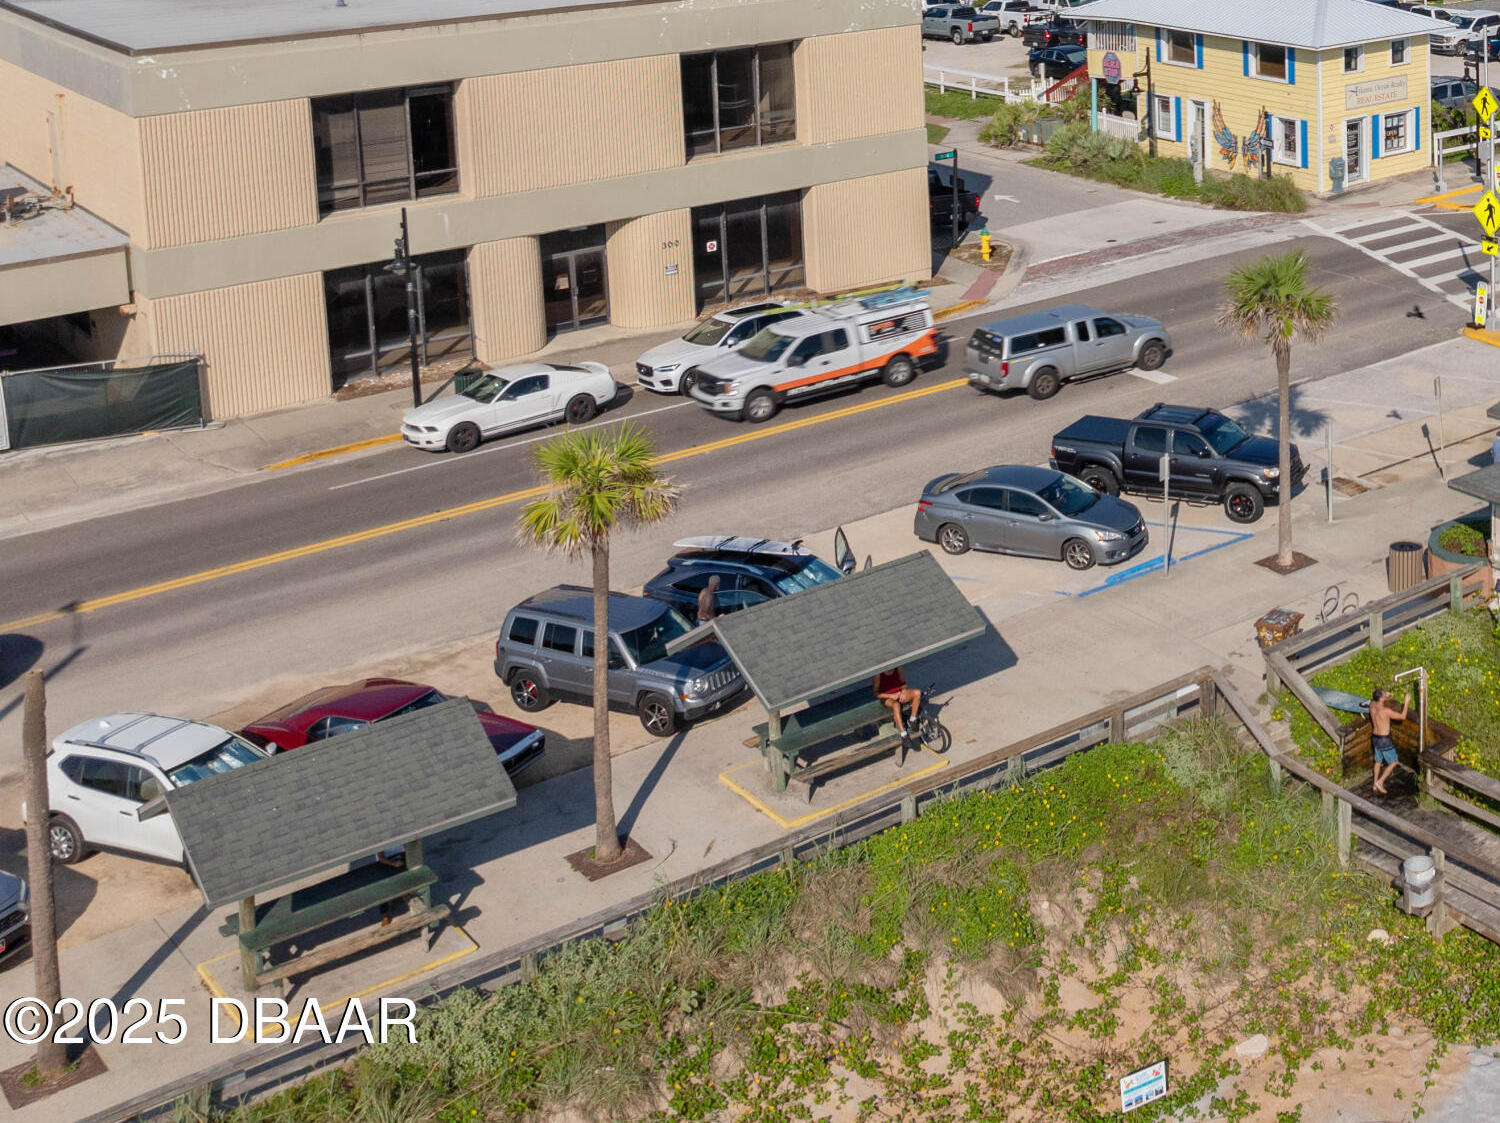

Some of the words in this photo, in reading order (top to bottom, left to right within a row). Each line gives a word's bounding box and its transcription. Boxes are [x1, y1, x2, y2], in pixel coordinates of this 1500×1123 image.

[1357, 94, 1372, 103] REAL
[1375, 90, 1398, 101] ESTATE
[661, 239, 680, 249] 300
